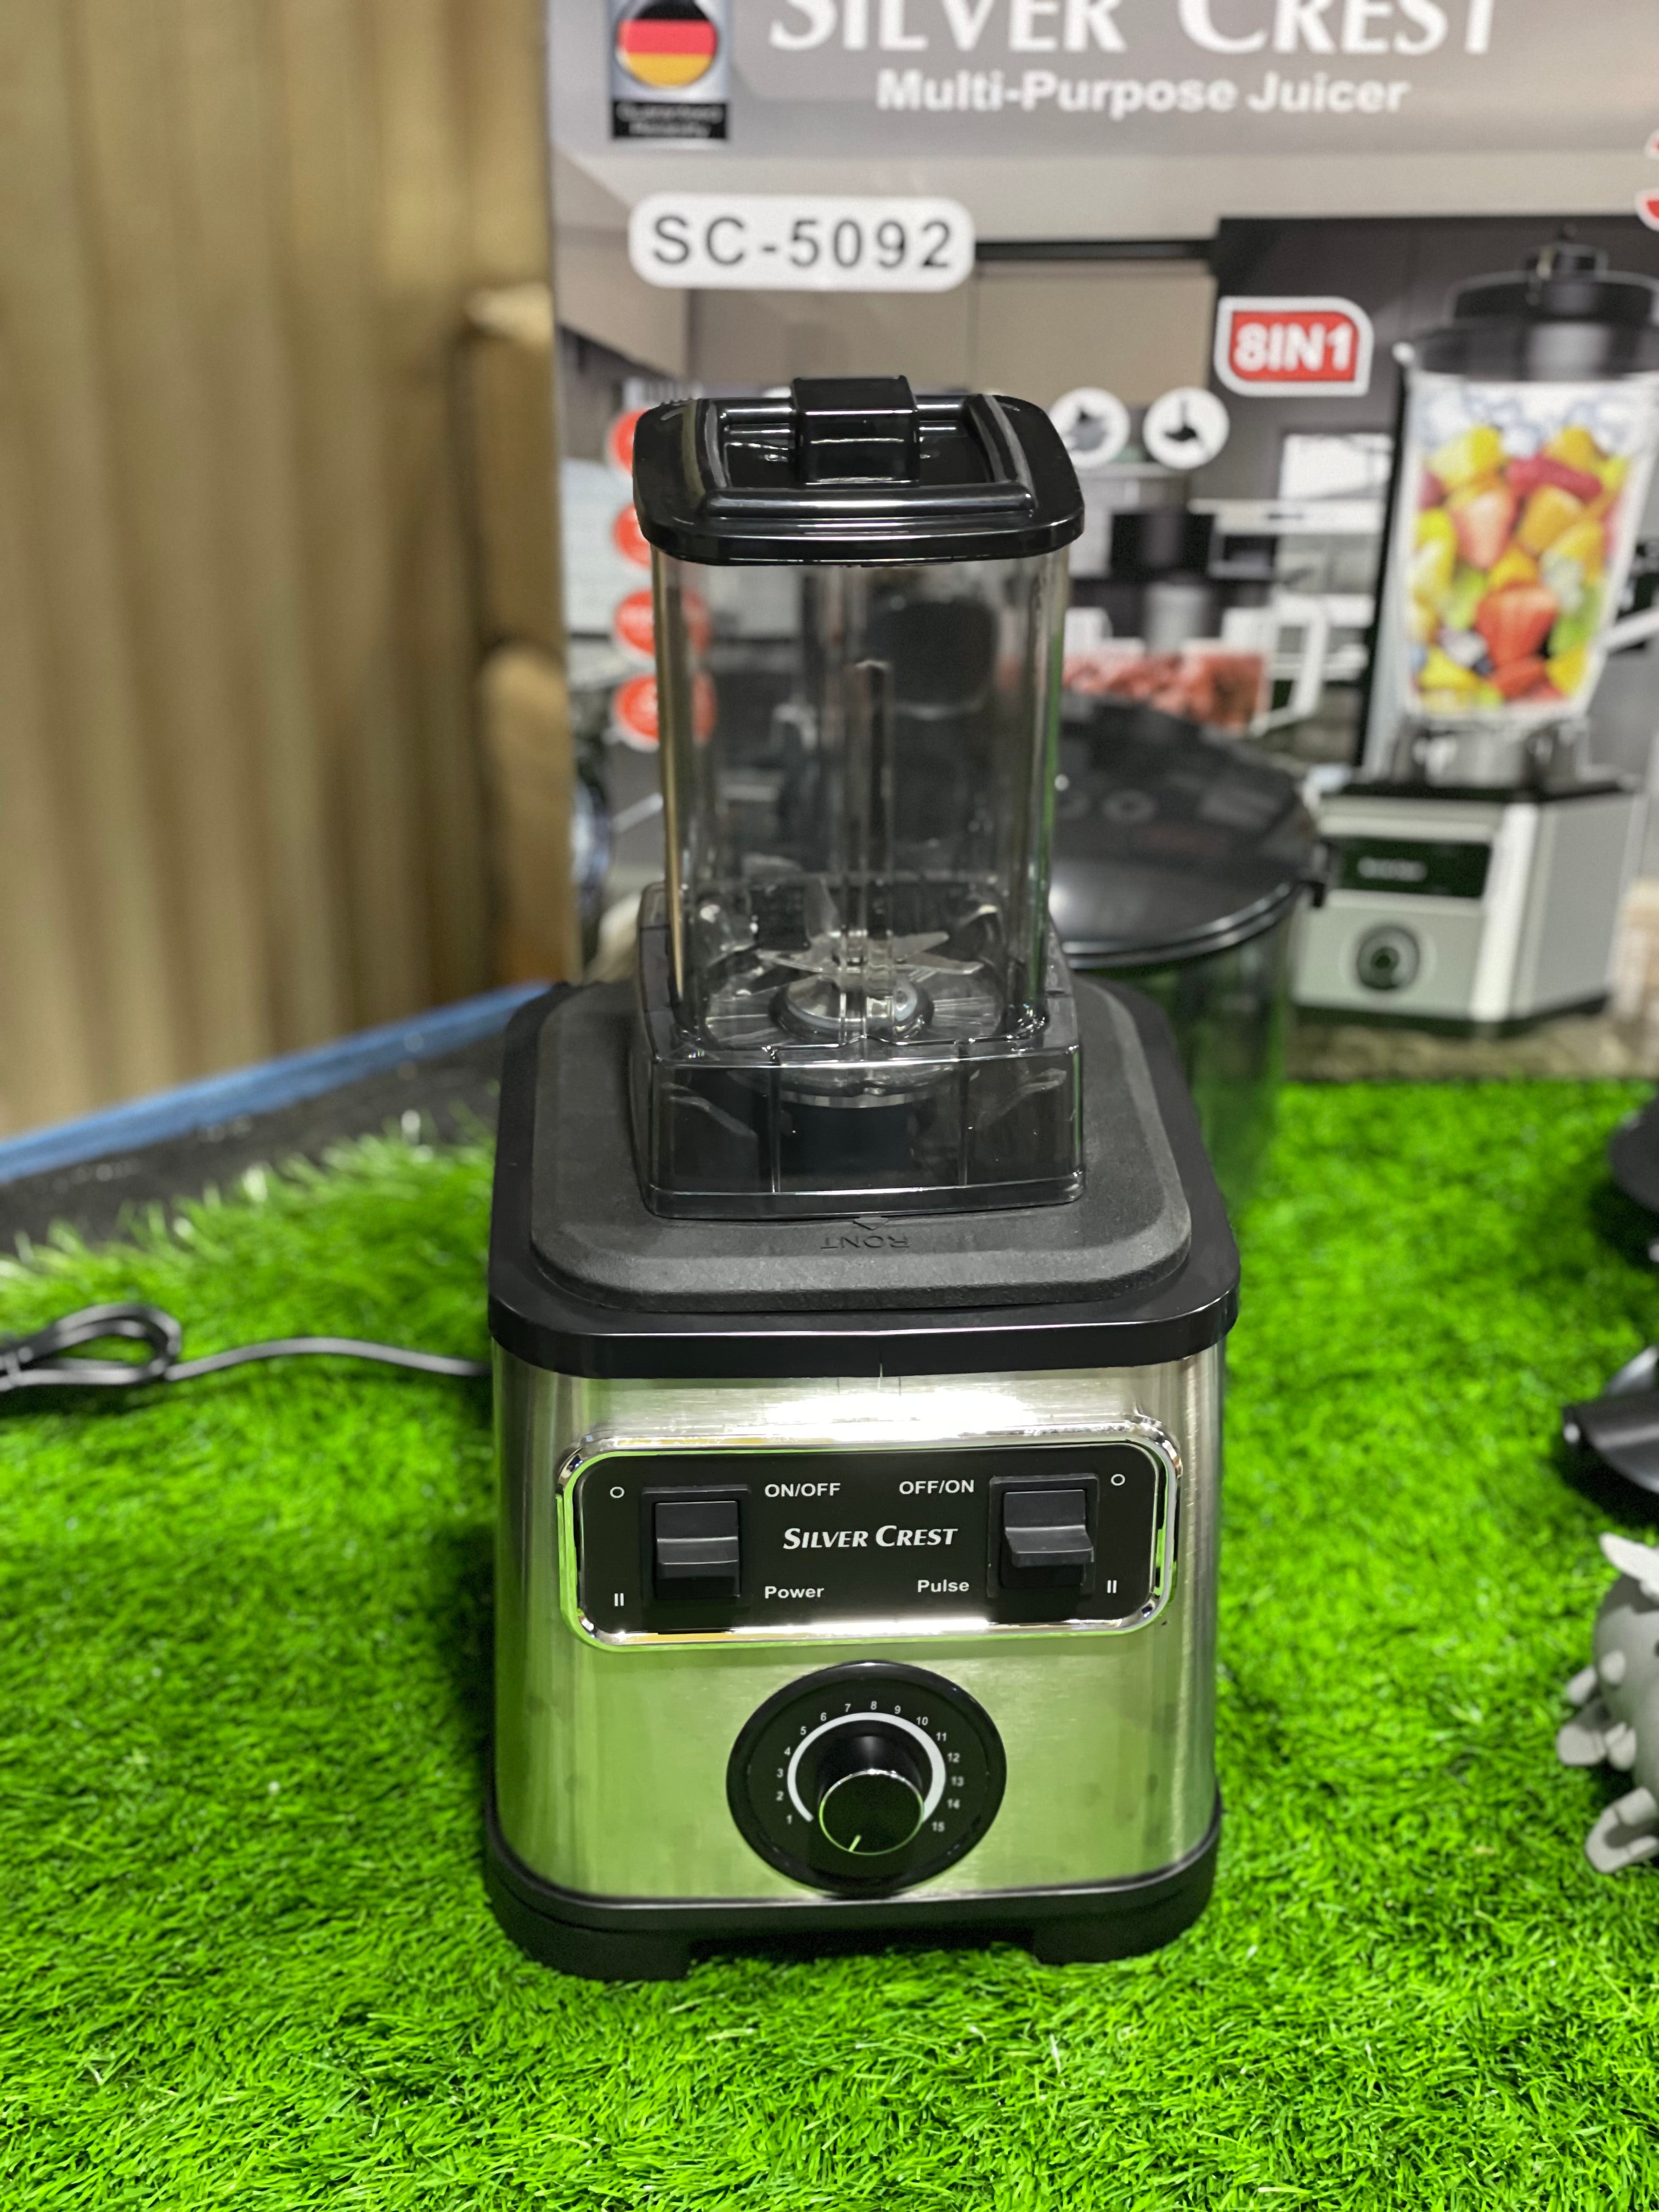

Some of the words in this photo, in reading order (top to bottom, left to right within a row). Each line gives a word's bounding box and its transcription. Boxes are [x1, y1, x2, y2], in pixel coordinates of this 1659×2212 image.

[769, 0, 1126, 51] SILVER
[878, 69, 1238, 121] Multi-Purpose
[1246, 71, 1411, 112] Juicer
[653, 216, 952, 270] SC-5092
[1233, 322, 1352, 372] 8IN1
[765, 1482, 841, 1498] ON/OFF
[899, 1479, 974, 1494] OFF/ON
[783, 1528, 867, 1550] SILVER
[876, 1525, 958, 1547] CREST
[917, 1579, 969, 1593] Pulse
[765, 1585, 825, 1599] Power
[845, 1703, 851, 1712] 7
[870, 1701, 877, 1710] 8
[894, 1705, 901, 1715] 9
[820, 1712, 827, 1722] 6
[916, 1716, 929, 1726] 10
[800, 1726, 807, 1736] 5
[935, 1732, 947, 1742] 11
[784, 1747, 791, 1756] 4
[947, 1752, 960, 1763] 12
[777, 1768, 783, 1778] 3
[951, 1776, 964, 1787] 13
[776, 1791, 784, 1801] 2
[947, 1799, 960, 1809] 14
[787, 1814, 792, 1824] 1
[932, 1821, 945, 1832] 15
